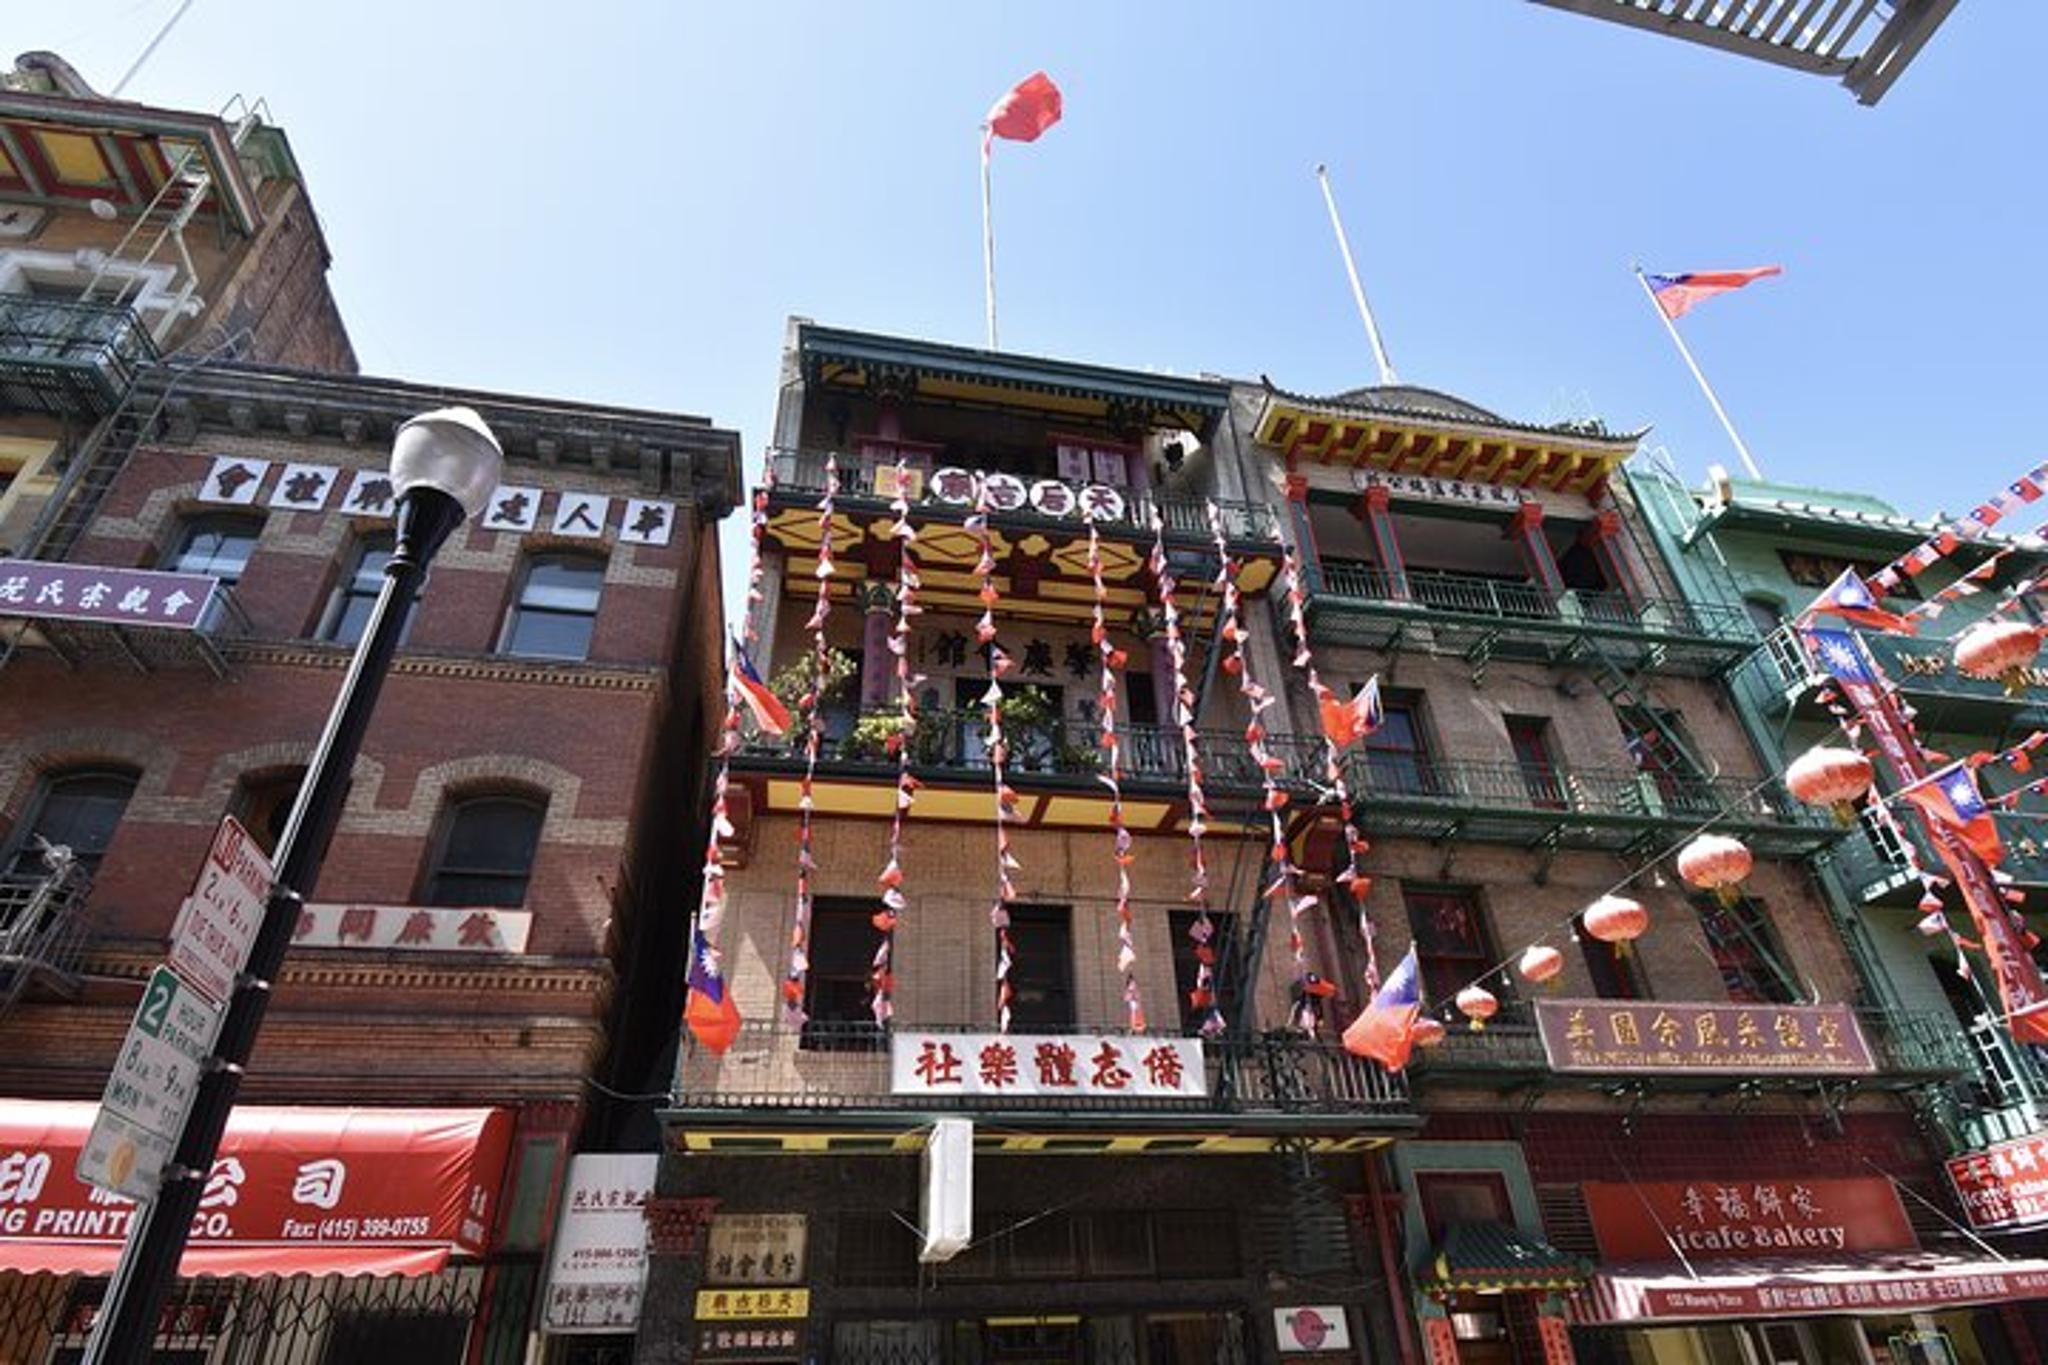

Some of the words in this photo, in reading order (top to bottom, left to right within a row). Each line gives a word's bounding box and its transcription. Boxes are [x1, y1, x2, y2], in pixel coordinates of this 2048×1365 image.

[144, 984, 170, 1027] 2
[281, 1218, 316, 1238] Fax:
[317, 1217, 356, 1241] (415)
